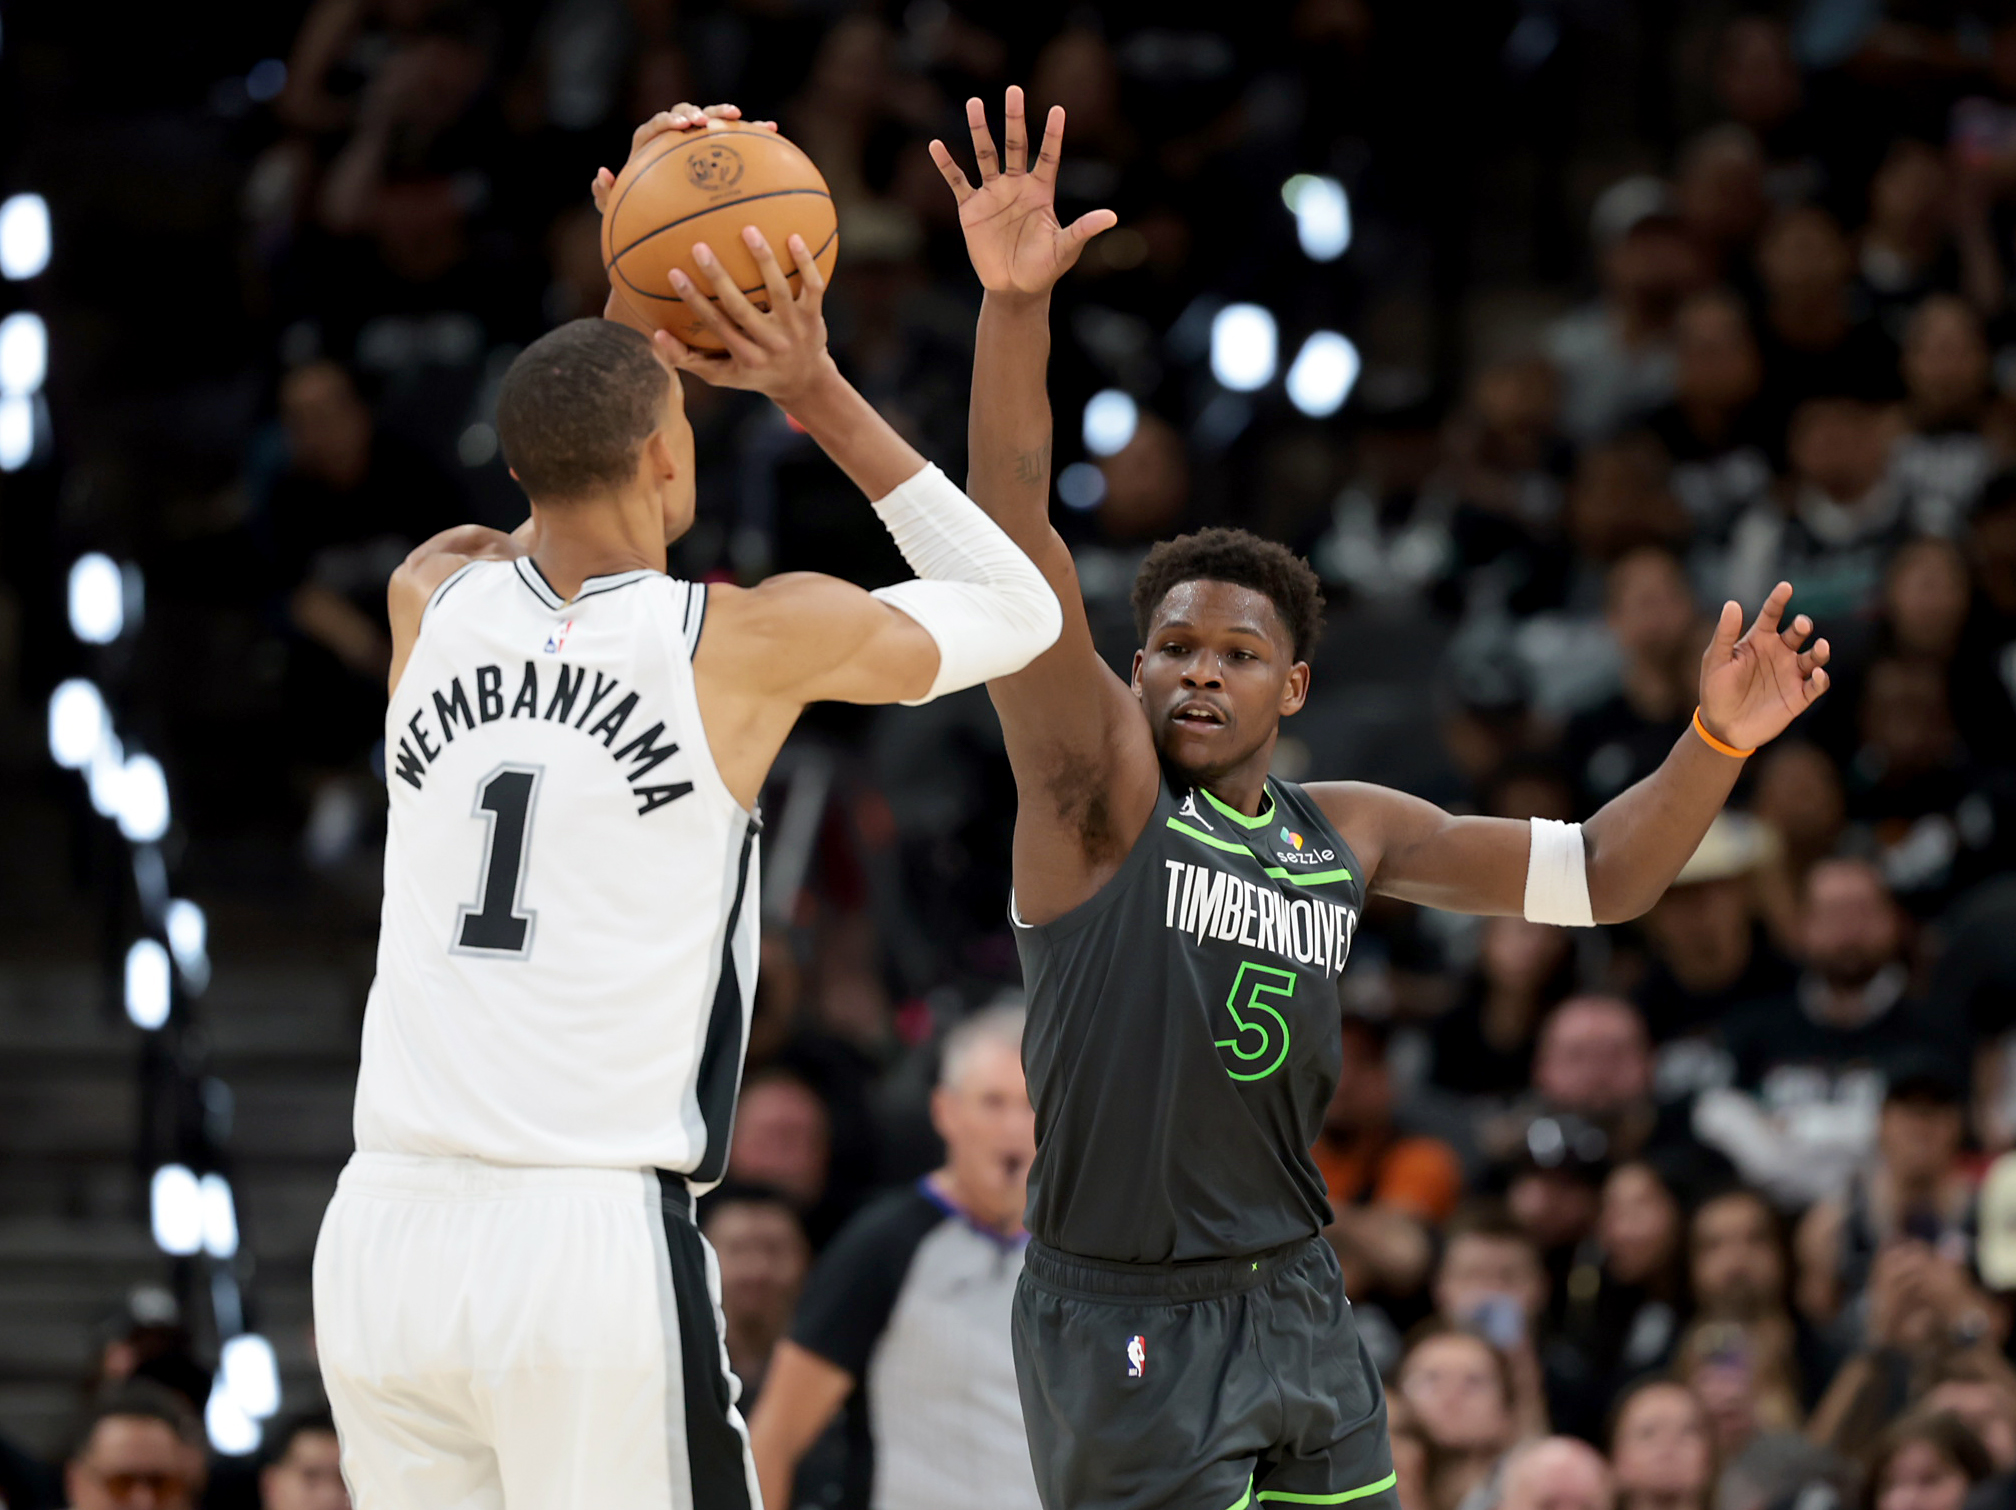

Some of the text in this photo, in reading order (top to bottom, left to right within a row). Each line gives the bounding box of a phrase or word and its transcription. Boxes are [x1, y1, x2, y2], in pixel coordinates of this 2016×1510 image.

[395, 660, 694, 816] WEMBANYAMA
[448, 761, 546, 961] 1
[1276, 847, 1335, 865] sezzle
[1214, 960, 1297, 1081] 5
